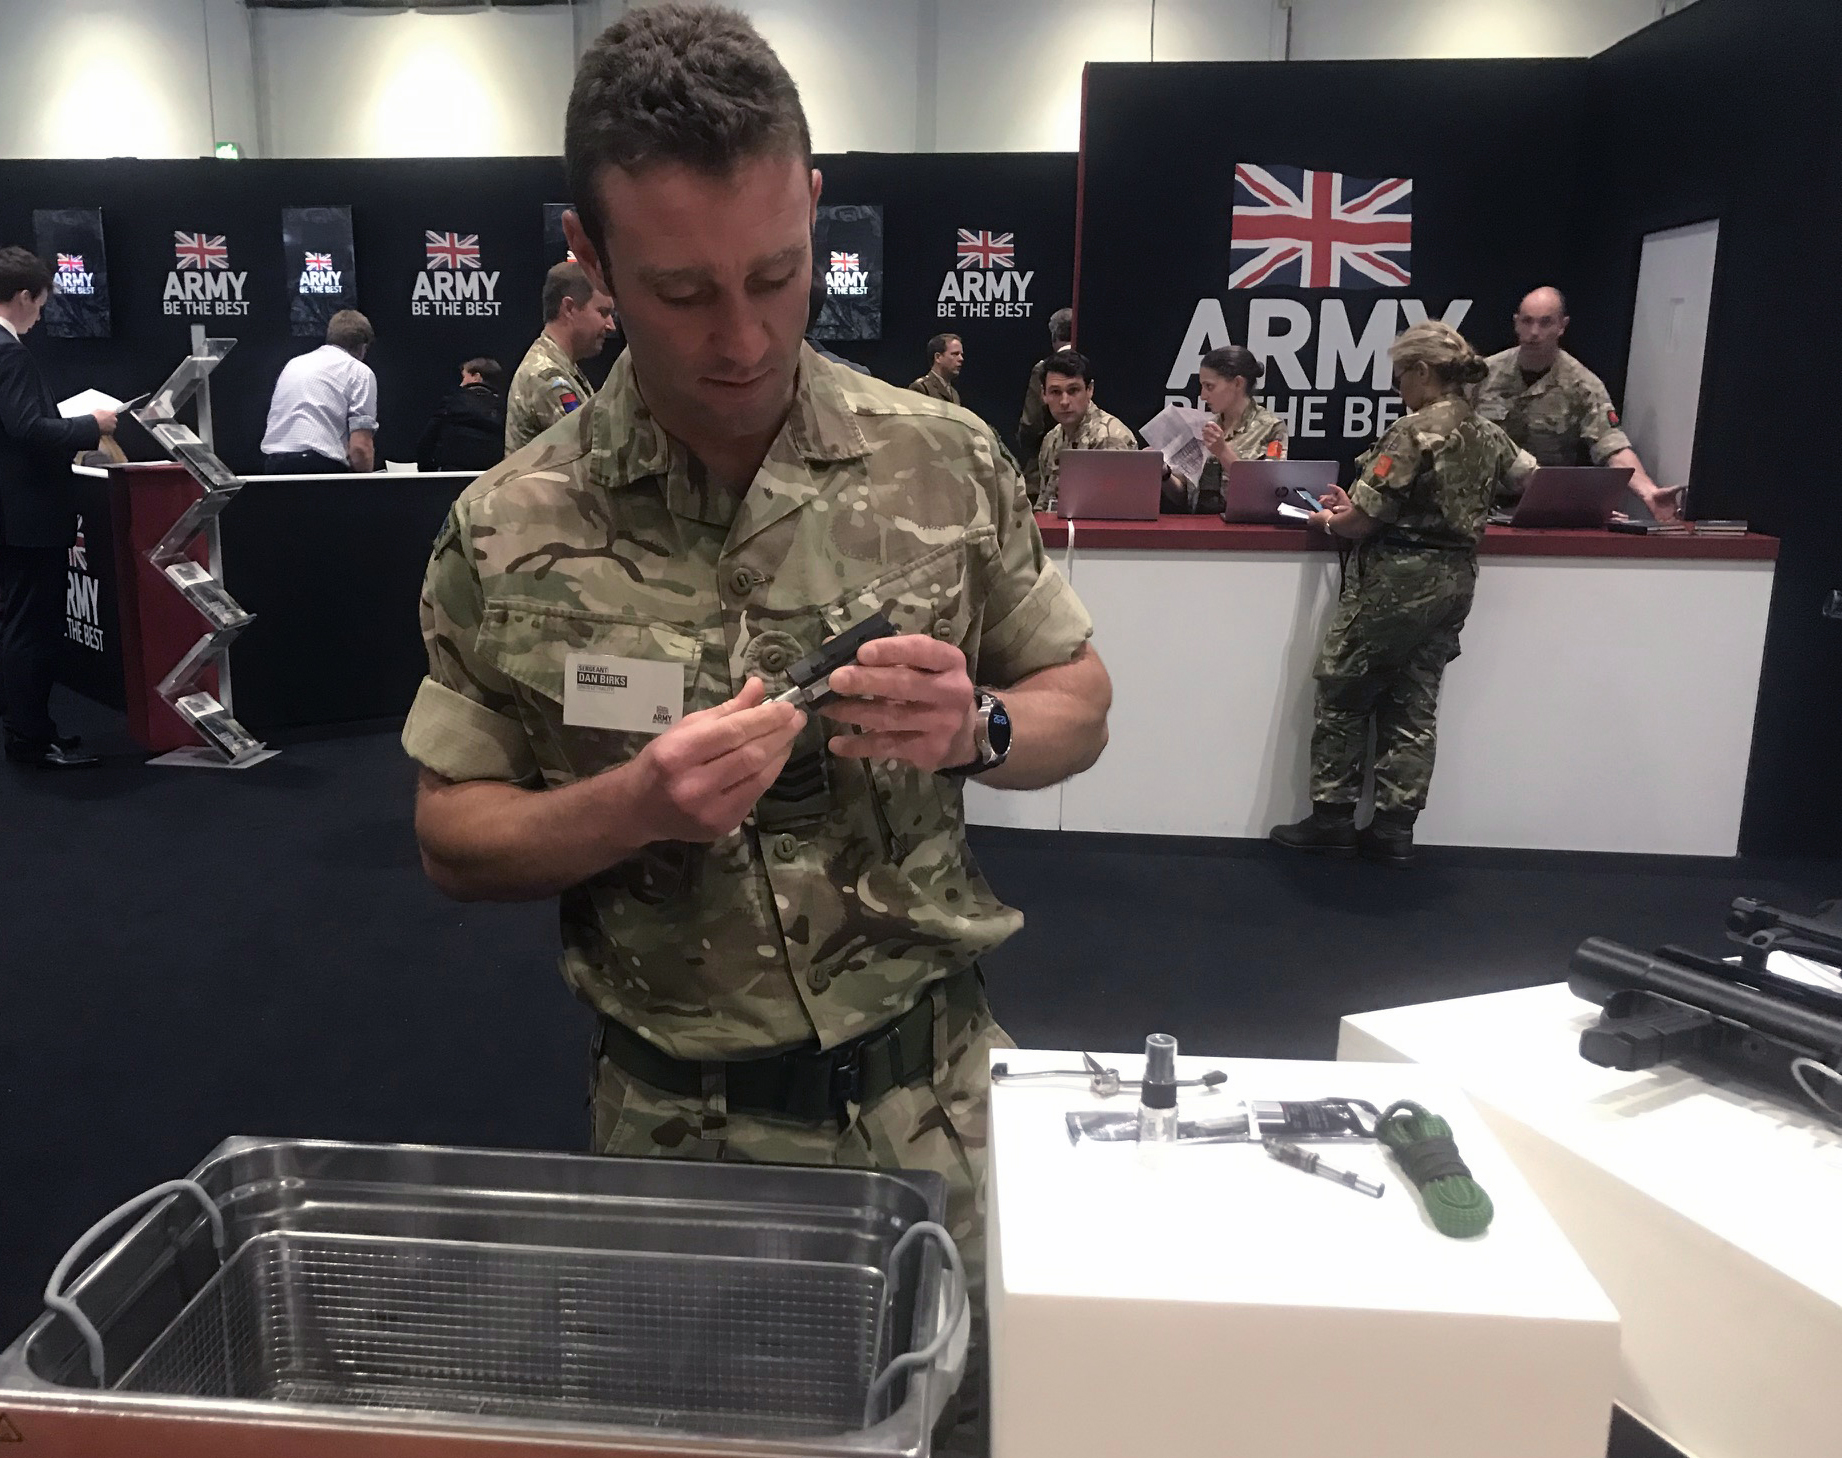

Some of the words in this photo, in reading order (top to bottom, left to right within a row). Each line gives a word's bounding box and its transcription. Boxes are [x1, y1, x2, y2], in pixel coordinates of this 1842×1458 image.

[52, 272, 94, 287] ARMY
[163, 271, 248, 301] ARMY
[299, 270, 342, 286] ARMY
[411, 271, 500, 301] ARMY
[825, 271, 869, 287] ARMY
[77, 286, 95, 295] BEST
[310, 285, 325, 294] THE
[324, 285, 343, 294] BEST
[833, 286, 849, 295] THE
[849, 286, 869, 295] BEST
[937, 271, 1035, 302] ARMY
[163, 301, 182, 315] BE
[183, 301, 212, 315] THE
[215, 301, 250, 316] BEST
[411, 301, 431, 316] BE
[432, 301, 462, 316] THE
[465, 301, 502, 316] BEST
[936, 302, 957, 318] BE
[959, 302, 990, 318] THE
[994, 302, 1034, 318] BEST
[1256, 395, 1329, 439] HE
[1342, 396, 1406, 439] BE
[66, 570, 99, 627] RMY
[66, 616, 84, 644] THE
[83, 623, 104, 652] BEST
[578, 673, 598, 683] DAN
[599, 675, 627, 686] BIRKS
[652, 713, 673, 721] ARMY
